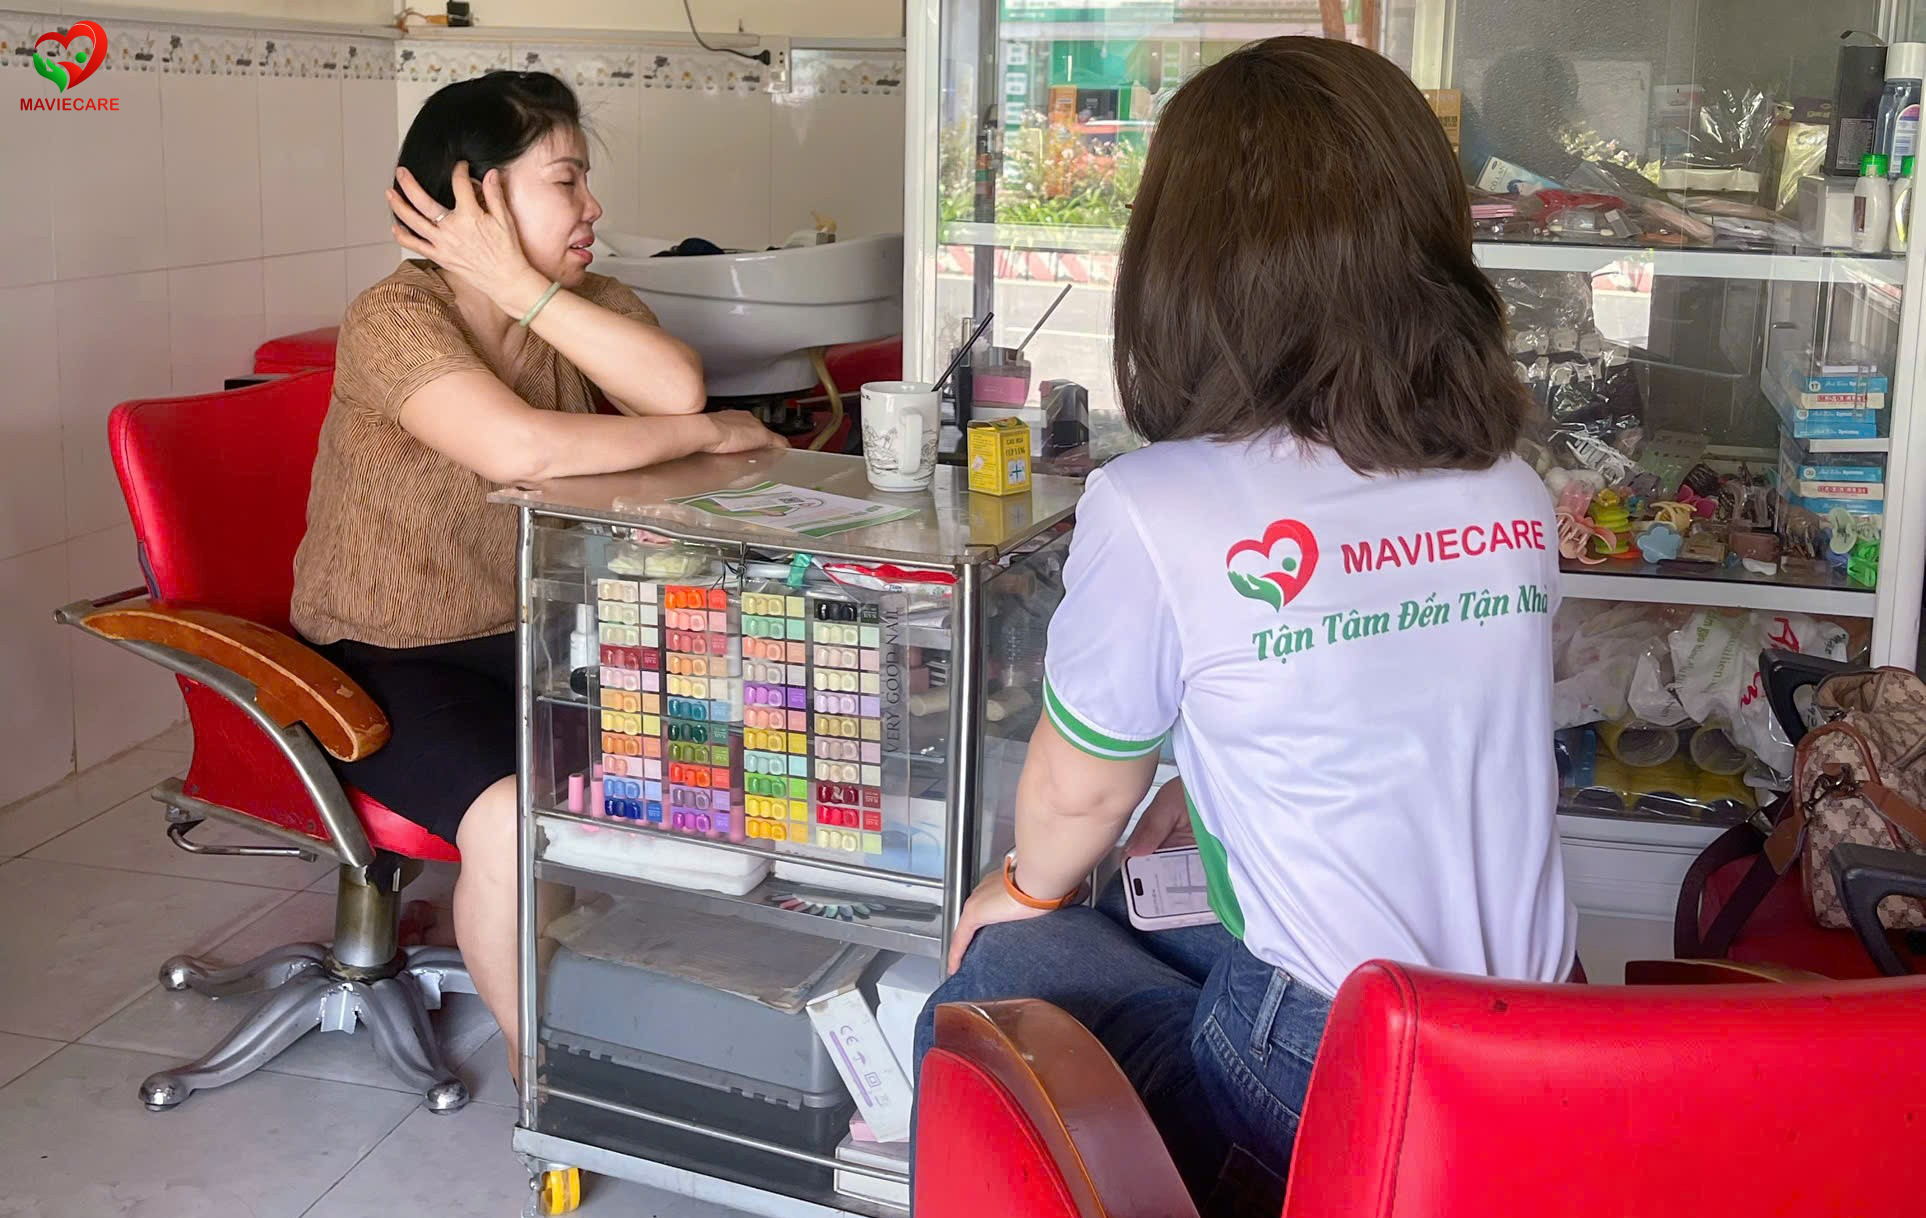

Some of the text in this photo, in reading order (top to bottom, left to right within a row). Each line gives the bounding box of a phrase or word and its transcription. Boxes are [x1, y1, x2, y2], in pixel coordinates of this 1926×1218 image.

[1341, 519, 1546, 574] MAVIECARE
[886, 607, 899, 644] NAIL
[1252, 584, 1548, 664] Tận Tâm Đến Tận Nhà
[886, 651, 900, 704] GOOD
[886, 711, 900, 752] VERY
